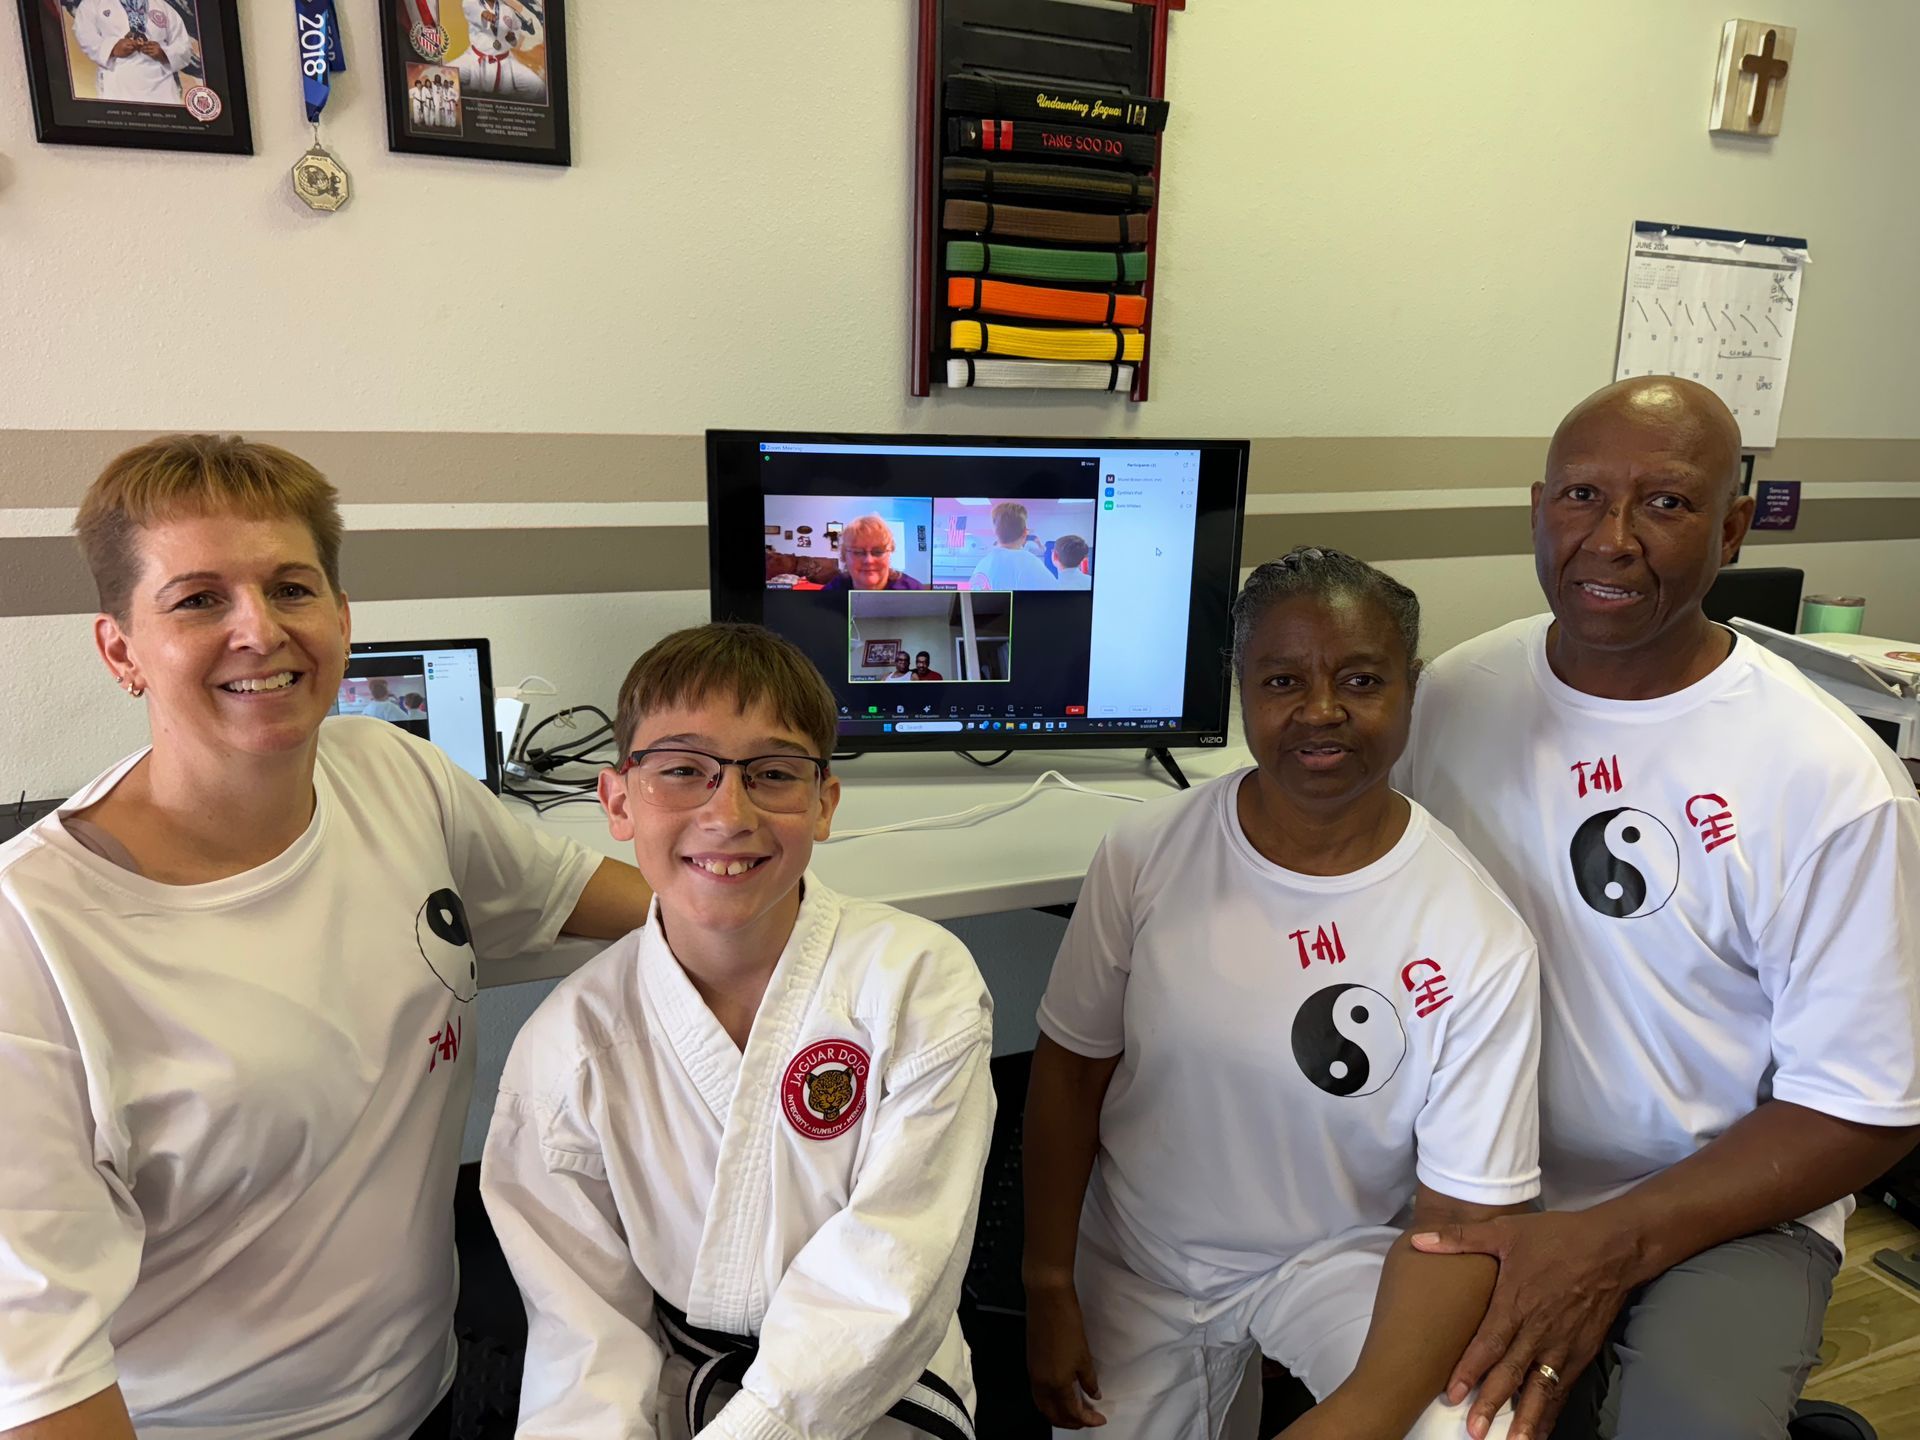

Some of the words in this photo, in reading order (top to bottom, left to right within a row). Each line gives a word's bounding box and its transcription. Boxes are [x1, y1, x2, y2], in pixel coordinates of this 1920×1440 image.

[299, 13, 327, 77] 2018
[1036, 93, 1089, 117] Undaunting
[1042, 133, 1073, 149] TANG
[1075, 136, 1102, 152] SOO
[1105, 140, 1123, 155] DO
[1636, 241, 1652, 250] JUNE
[1653, 242, 1669, 251] 2024
[1200, 736, 1223, 744] VIZIO
[1571, 754, 1623, 798] TAI
[1685, 793, 1737, 854] CHI
[1288, 921, 1346, 969] TAI
[1401, 957, 1454, 1018] CHI
[428, 1015, 462, 1073] TAI
[790, 1047, 835, 1087] JAGUAR
[838, 1048, 866, 1076] DOJO
[787, 1094, 810, 1128] INTEGRITY
[811, 1123, 843, 1134] HUMILITY
